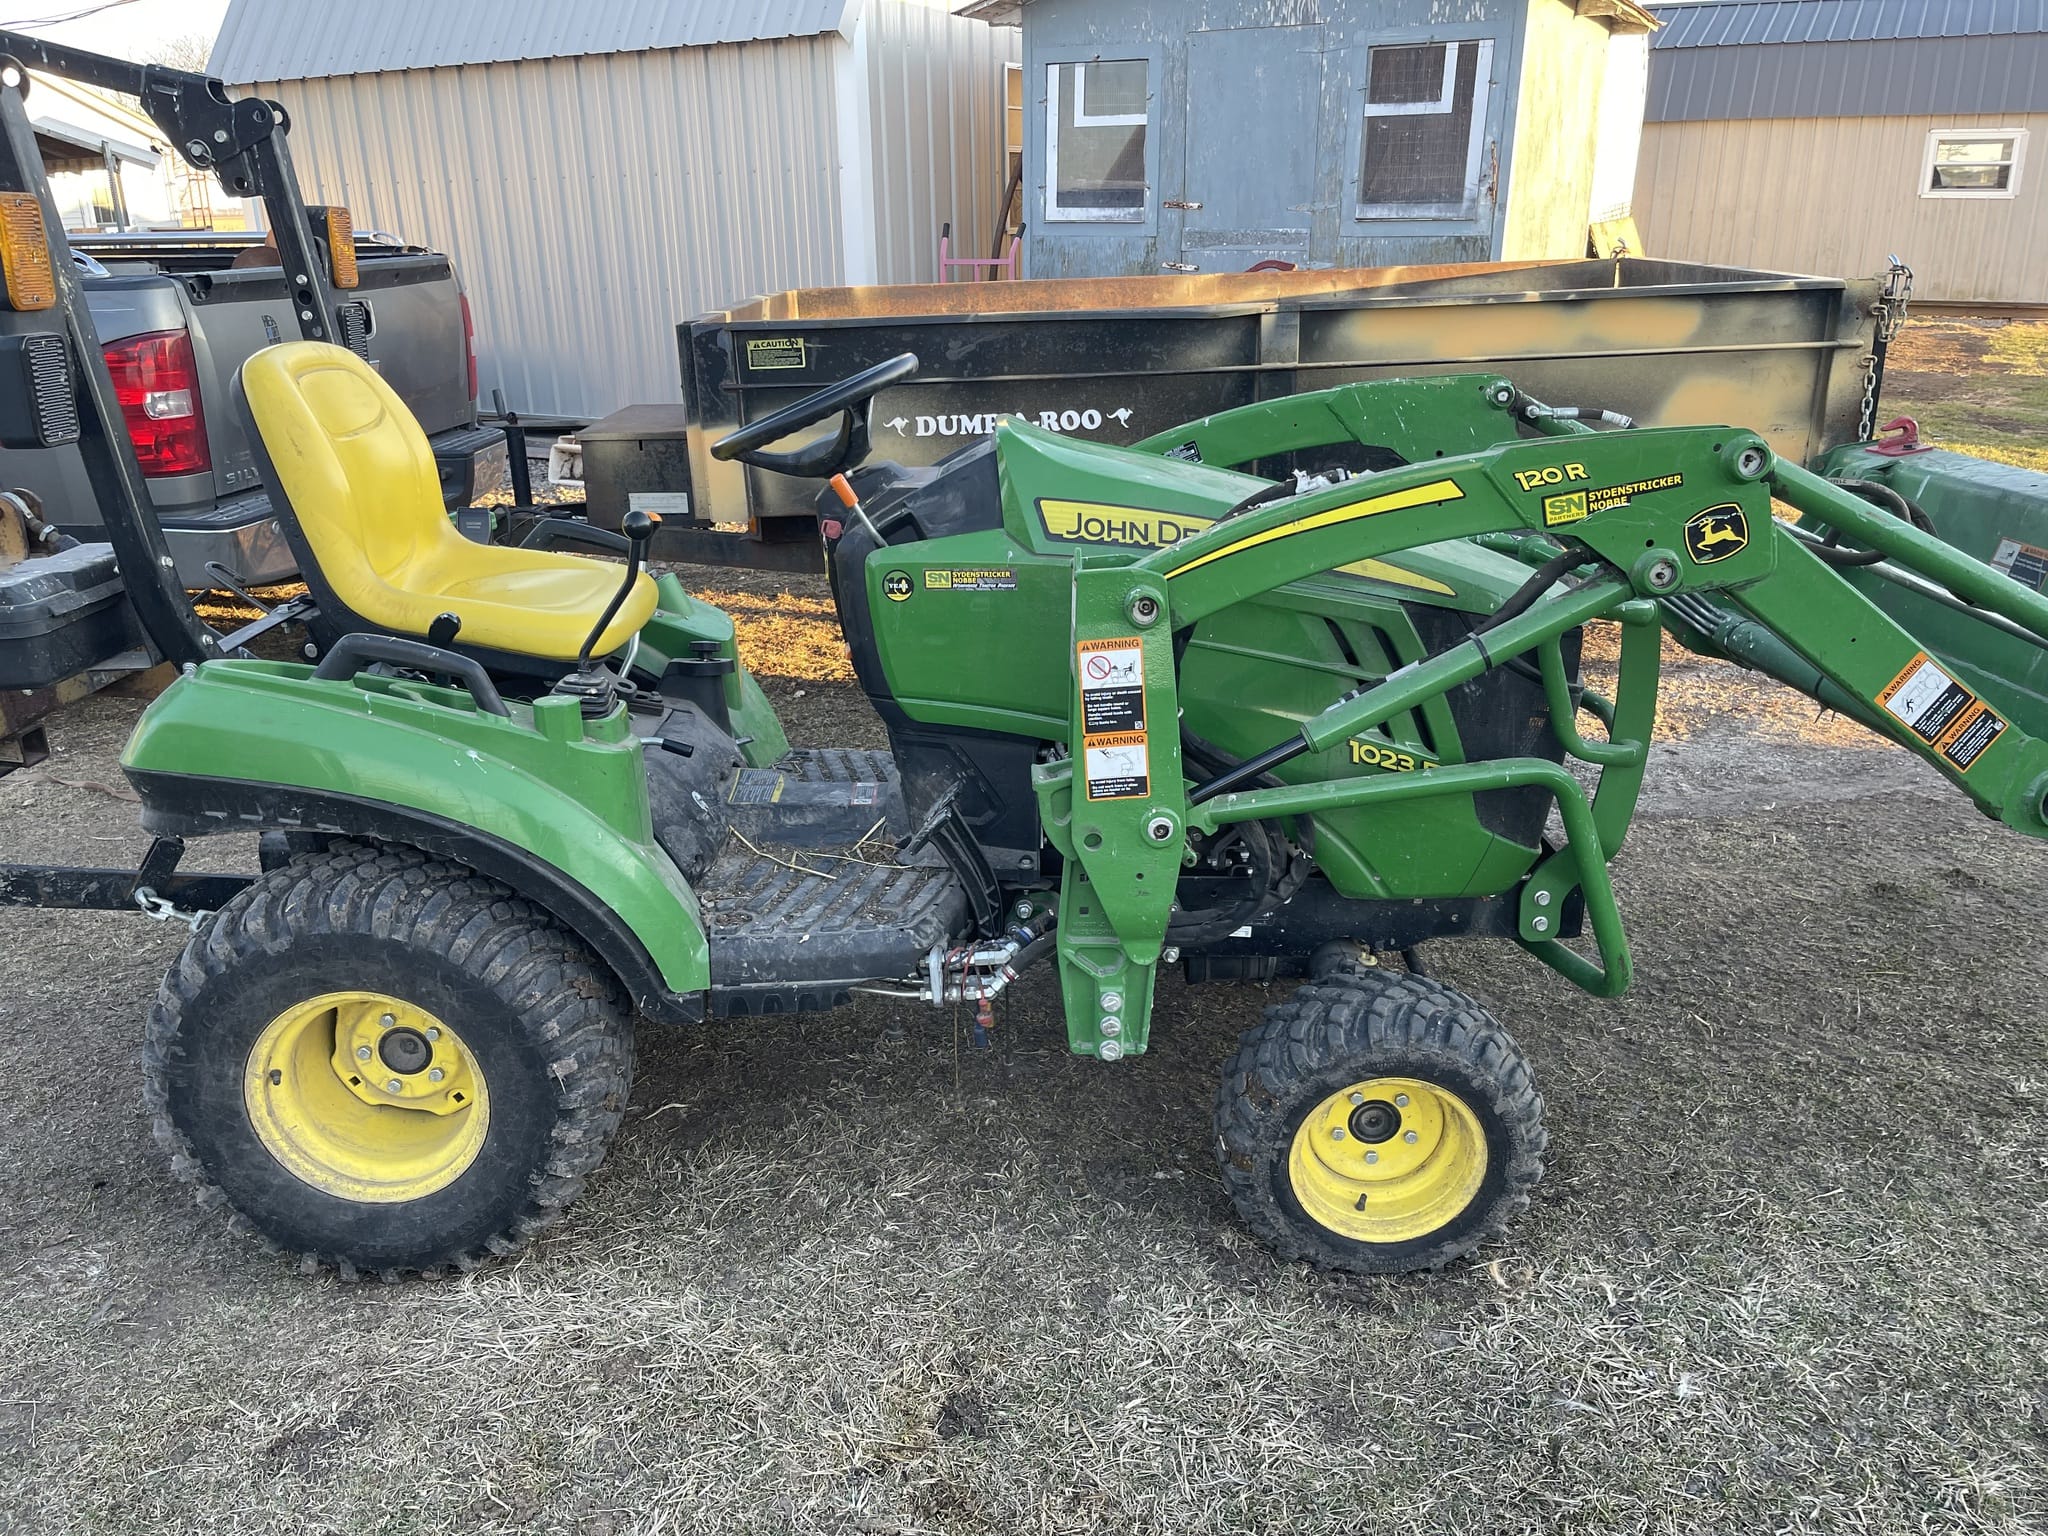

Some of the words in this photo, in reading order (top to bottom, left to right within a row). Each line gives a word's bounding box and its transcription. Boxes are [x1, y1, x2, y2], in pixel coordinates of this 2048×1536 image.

[761, 339, 798, 348] CAUTION
[1514, 466, 1563, 491] 120
[1565, 462, 1590, 481] R
[1588, 475, 1682, 501] SYDENSTRICKER
[1549, 495, 1584, 516] SN
[1589, 496, 1628, 512] NOBBE
[1066, 512, 1149, 541] JOHN
[1549, 511, 1585, 522] PARTNERS
[927, 572, 950, 584] SN
[1090, 639, 1140, 650] WARNING
[1889, 659, 1922, 692] WARNING
[1948, 707, 1981, 740] WARNING
[1096, 735, 1144, 746] WARNING
[1348, 739, 1415, 772] 1023
